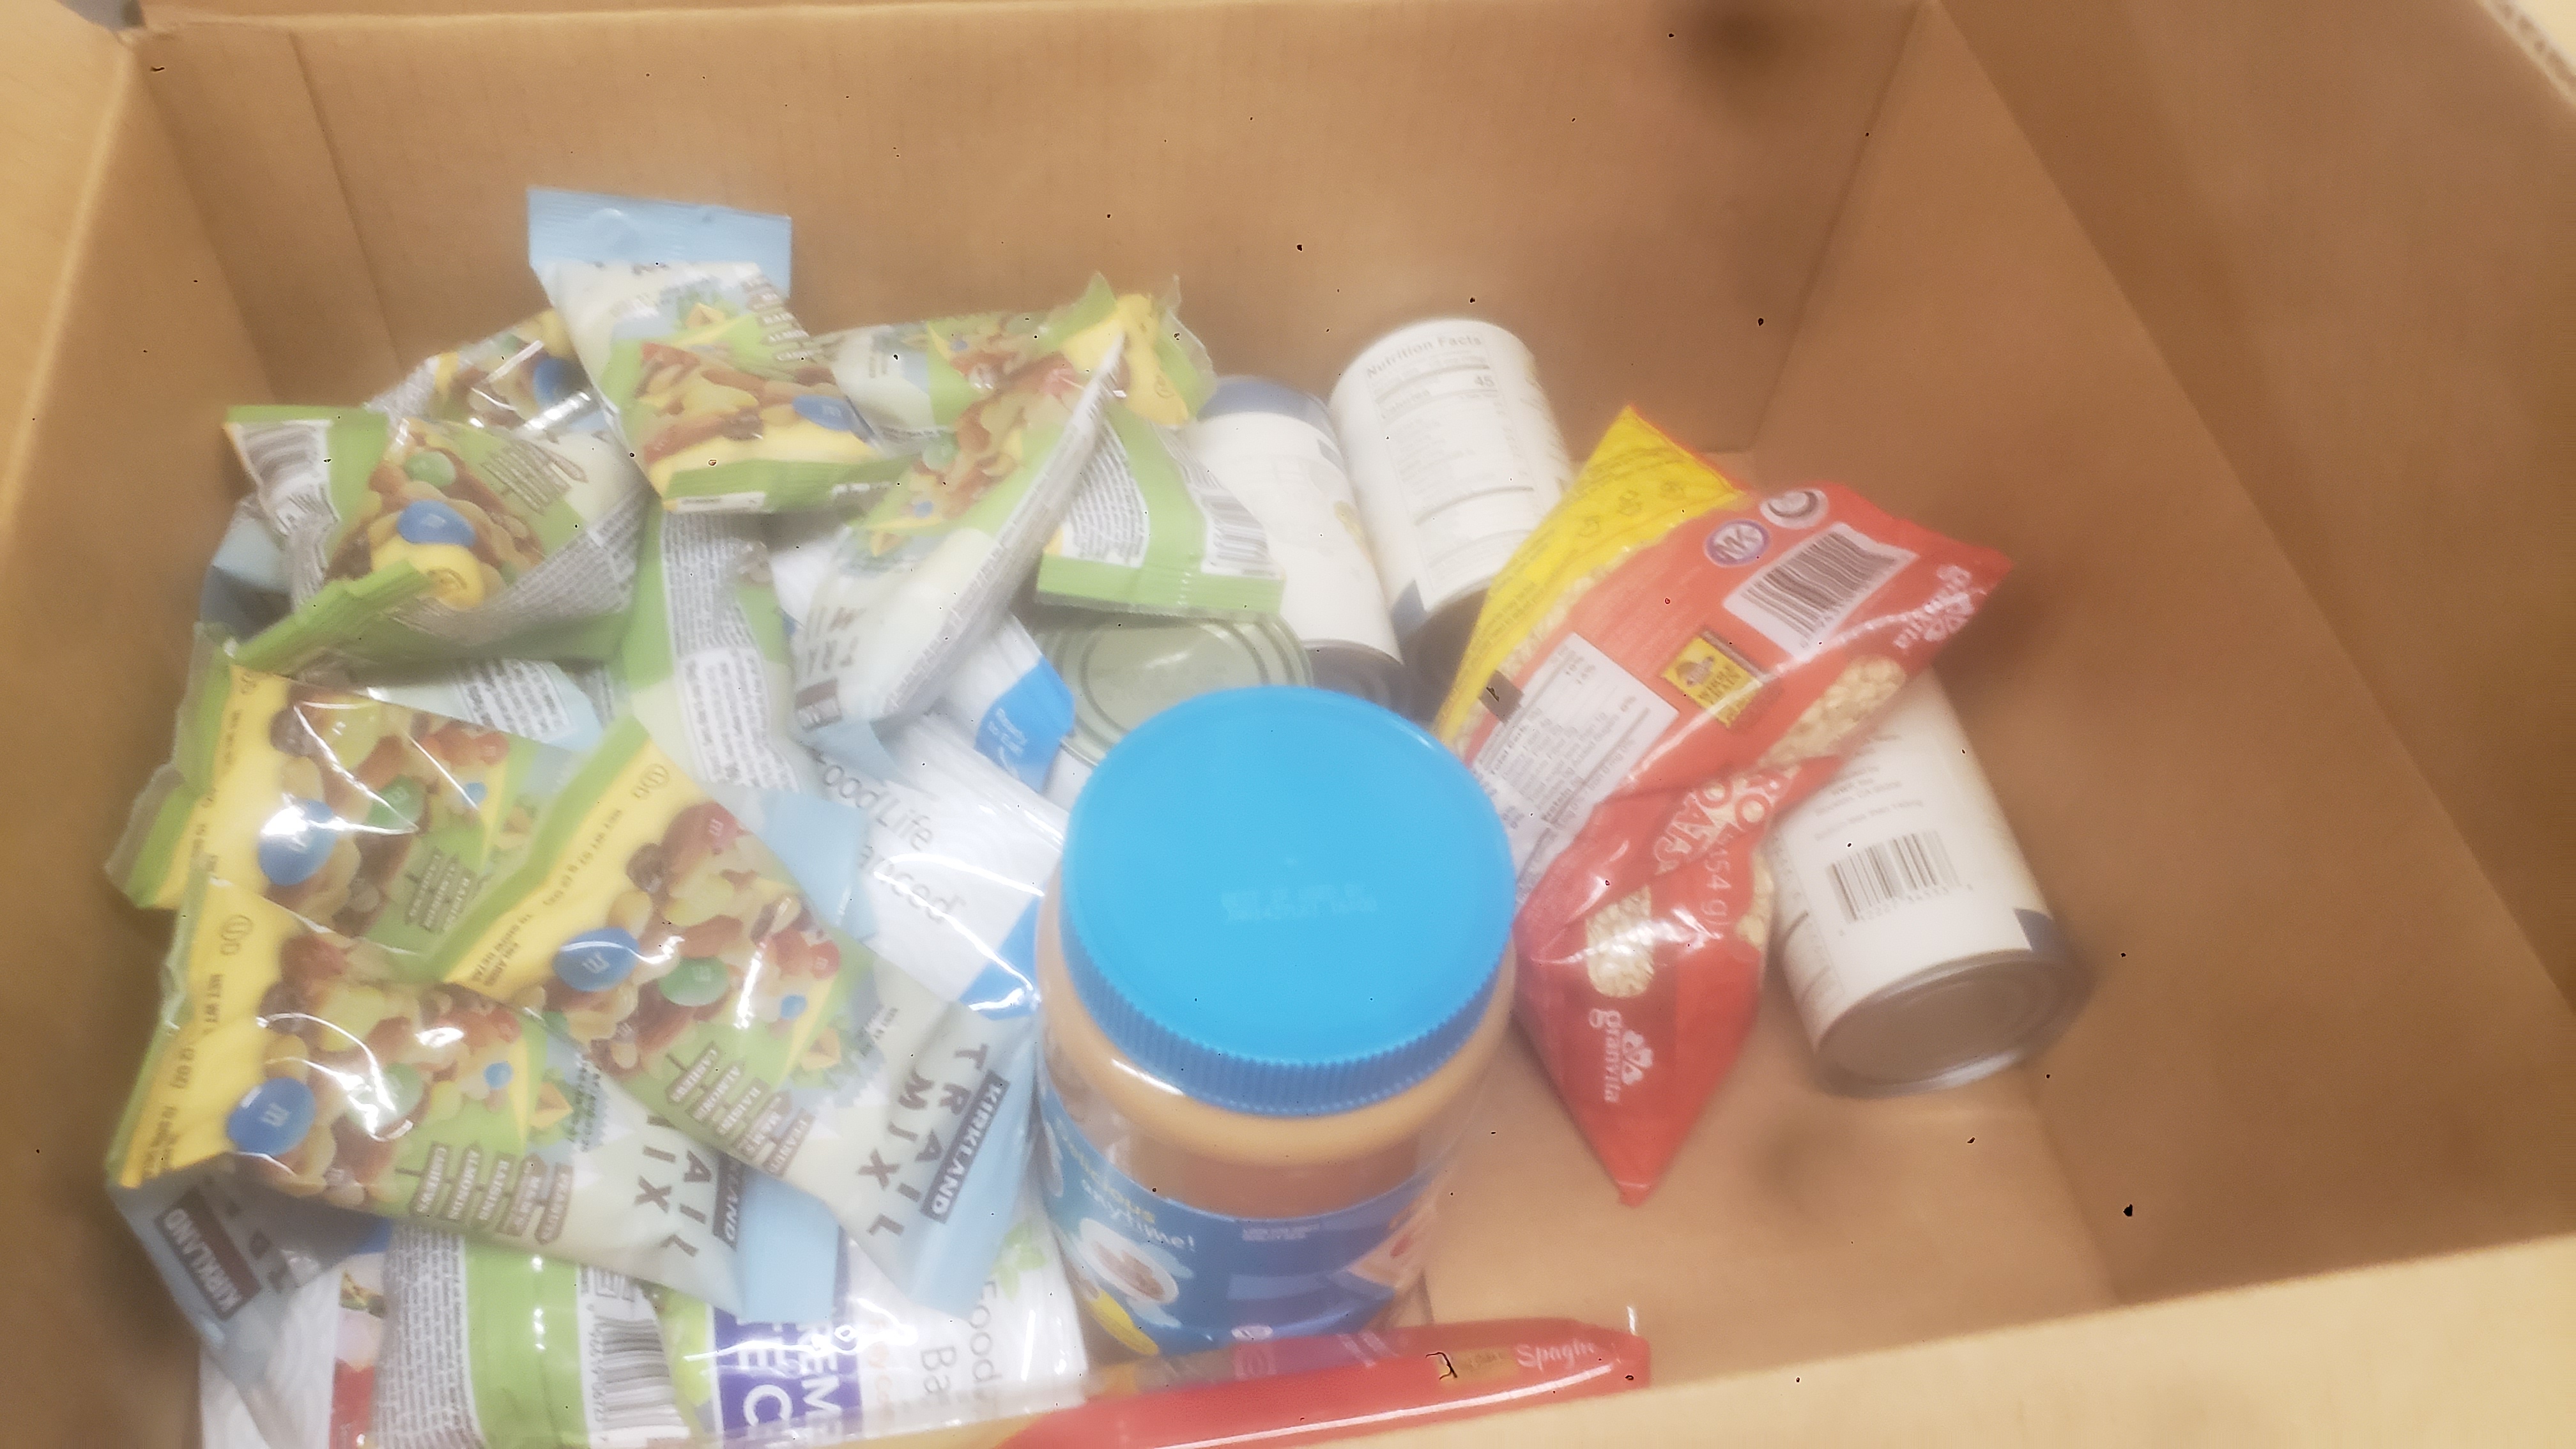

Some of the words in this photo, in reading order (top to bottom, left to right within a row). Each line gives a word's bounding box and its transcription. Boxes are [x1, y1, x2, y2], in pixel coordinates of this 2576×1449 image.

[1367, 341, 1433, 378] Nutrition
[1438, 335, 1482, 353] Facts
[1475, 374, 1495, 387] 45
[1589, 1009, 1622, 1103] granvita
[857, 1069, 933, 1189] MIX
[868, 1044, 988, 1236] TRAIL
[931, 1083, 1004, 1215] KIRKLAND
[661, 1151, 713, 1258] AIL
[165, 1208, 242, 1314] KIRKLAND
